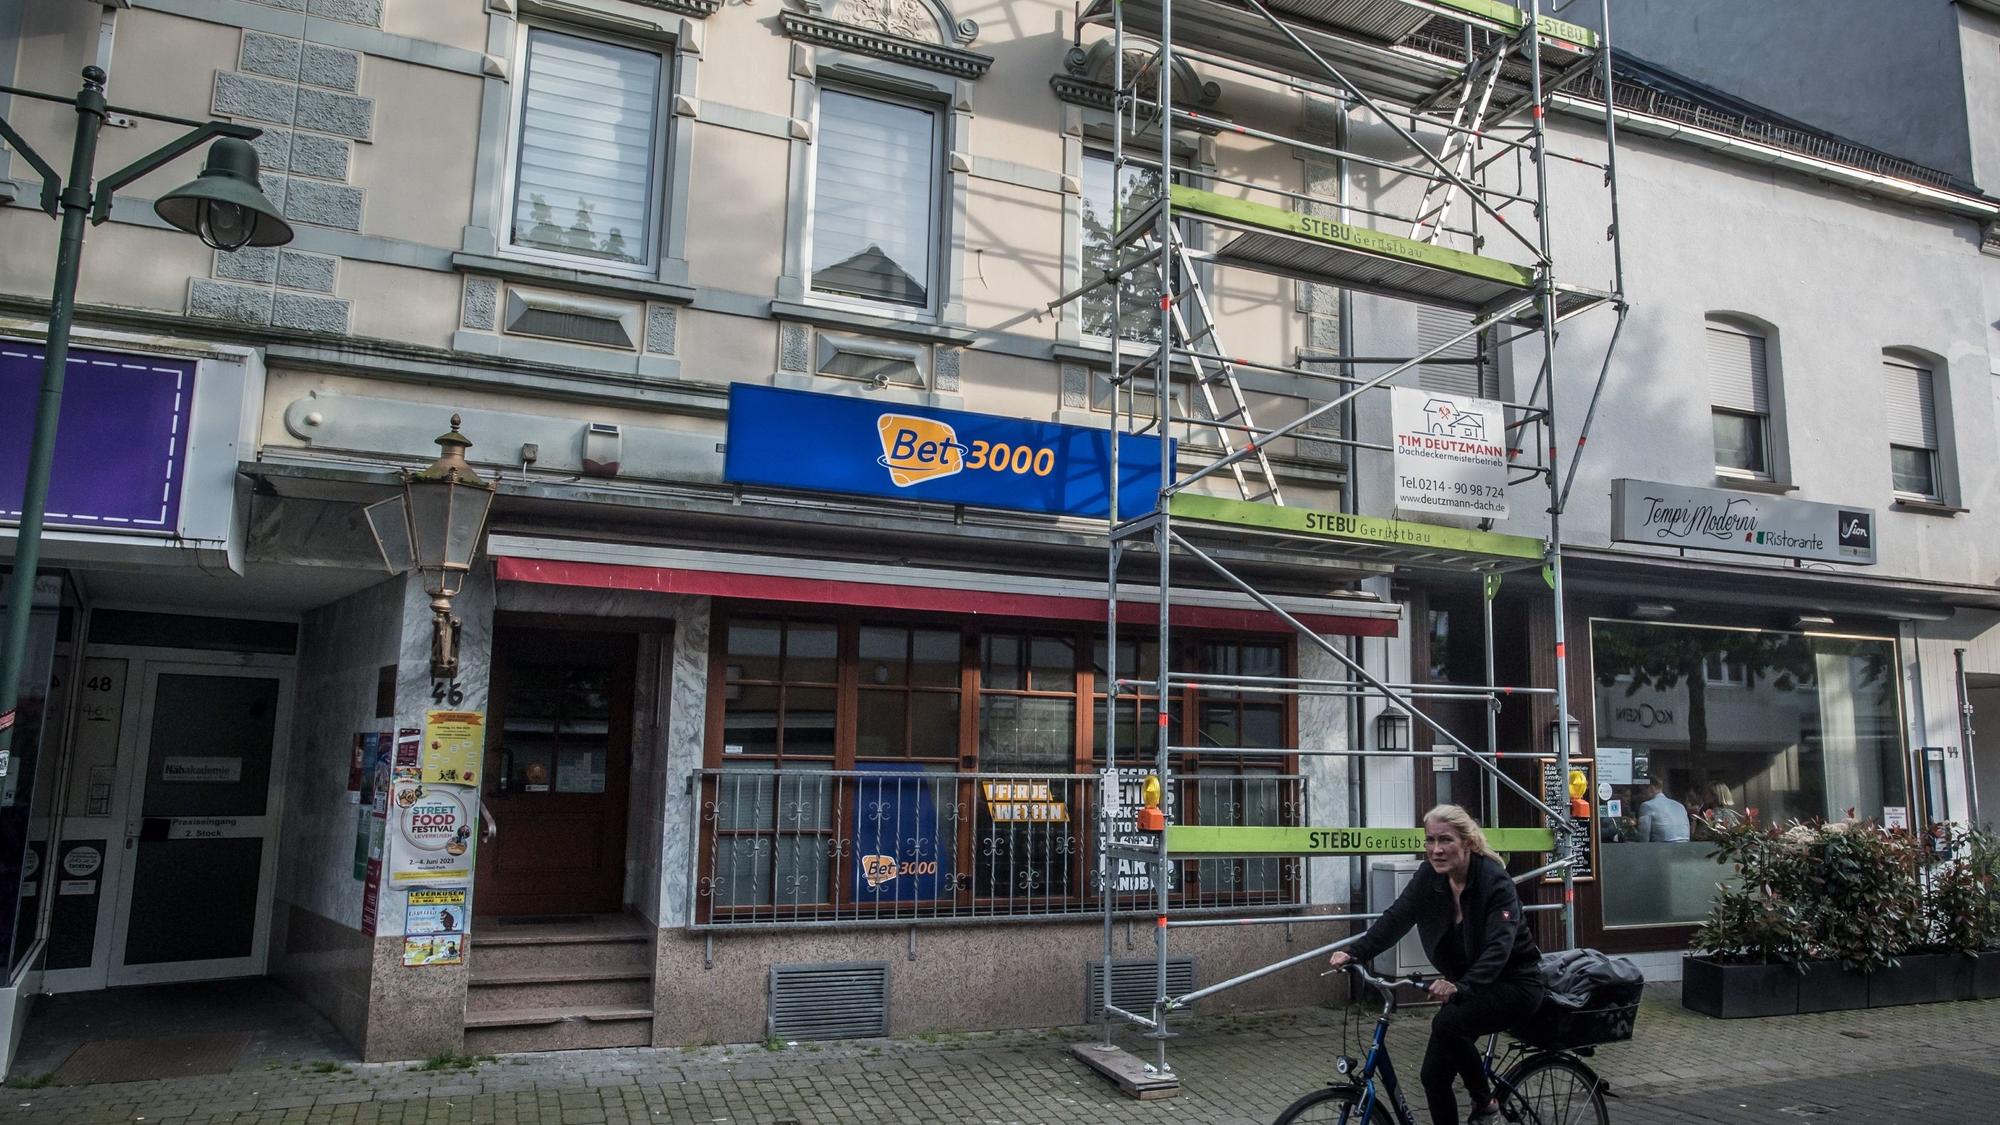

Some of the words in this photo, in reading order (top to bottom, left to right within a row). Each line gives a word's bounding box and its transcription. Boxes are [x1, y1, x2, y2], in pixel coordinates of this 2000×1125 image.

[1545, 20, 1583, 42] STEBU
[1301, 218, 1350, 241] STEBU
[890, 428, 952, 465] Bet
[965, 440, 1055, 477] 3000
[1398, 434, 1421, 448] TIM
[1425, 437, 1503, 457] DEUTZMANN
[1398, 445, 1503, 467] Dachdeckermeisterbetrieb
[1454, 482, 1468, 495] 90
[1471, 484, 1483, 497] 98
[1485, 485, 1504, 499] 724
[1400, 494, 1505, 512] www.deutzmann-dach.de
[1306, 513, 1356, 533] STEBU
[1360, 524, 1430, 543] Gerüstbau
[1643, 497, 1692, 538] Tempi
[1685, 498, 1759, 540] Moderni
[1766, 530, 1823, 550] Ristorante
[87, 676, 112, 692] 48
[431, 681, 463, 706] 46
[412, 814, 455, 826] FOOD
[413, 806, 456, 815] STREET
[412, 825, 454, 833] FESTIVAL
[1309, 832, 1361, 849] STEBU
[1365, 835, 1427, 849] Gerüstb
[868, 861, 896, 875] Bet
[899, 861, 937, 875] 3000
